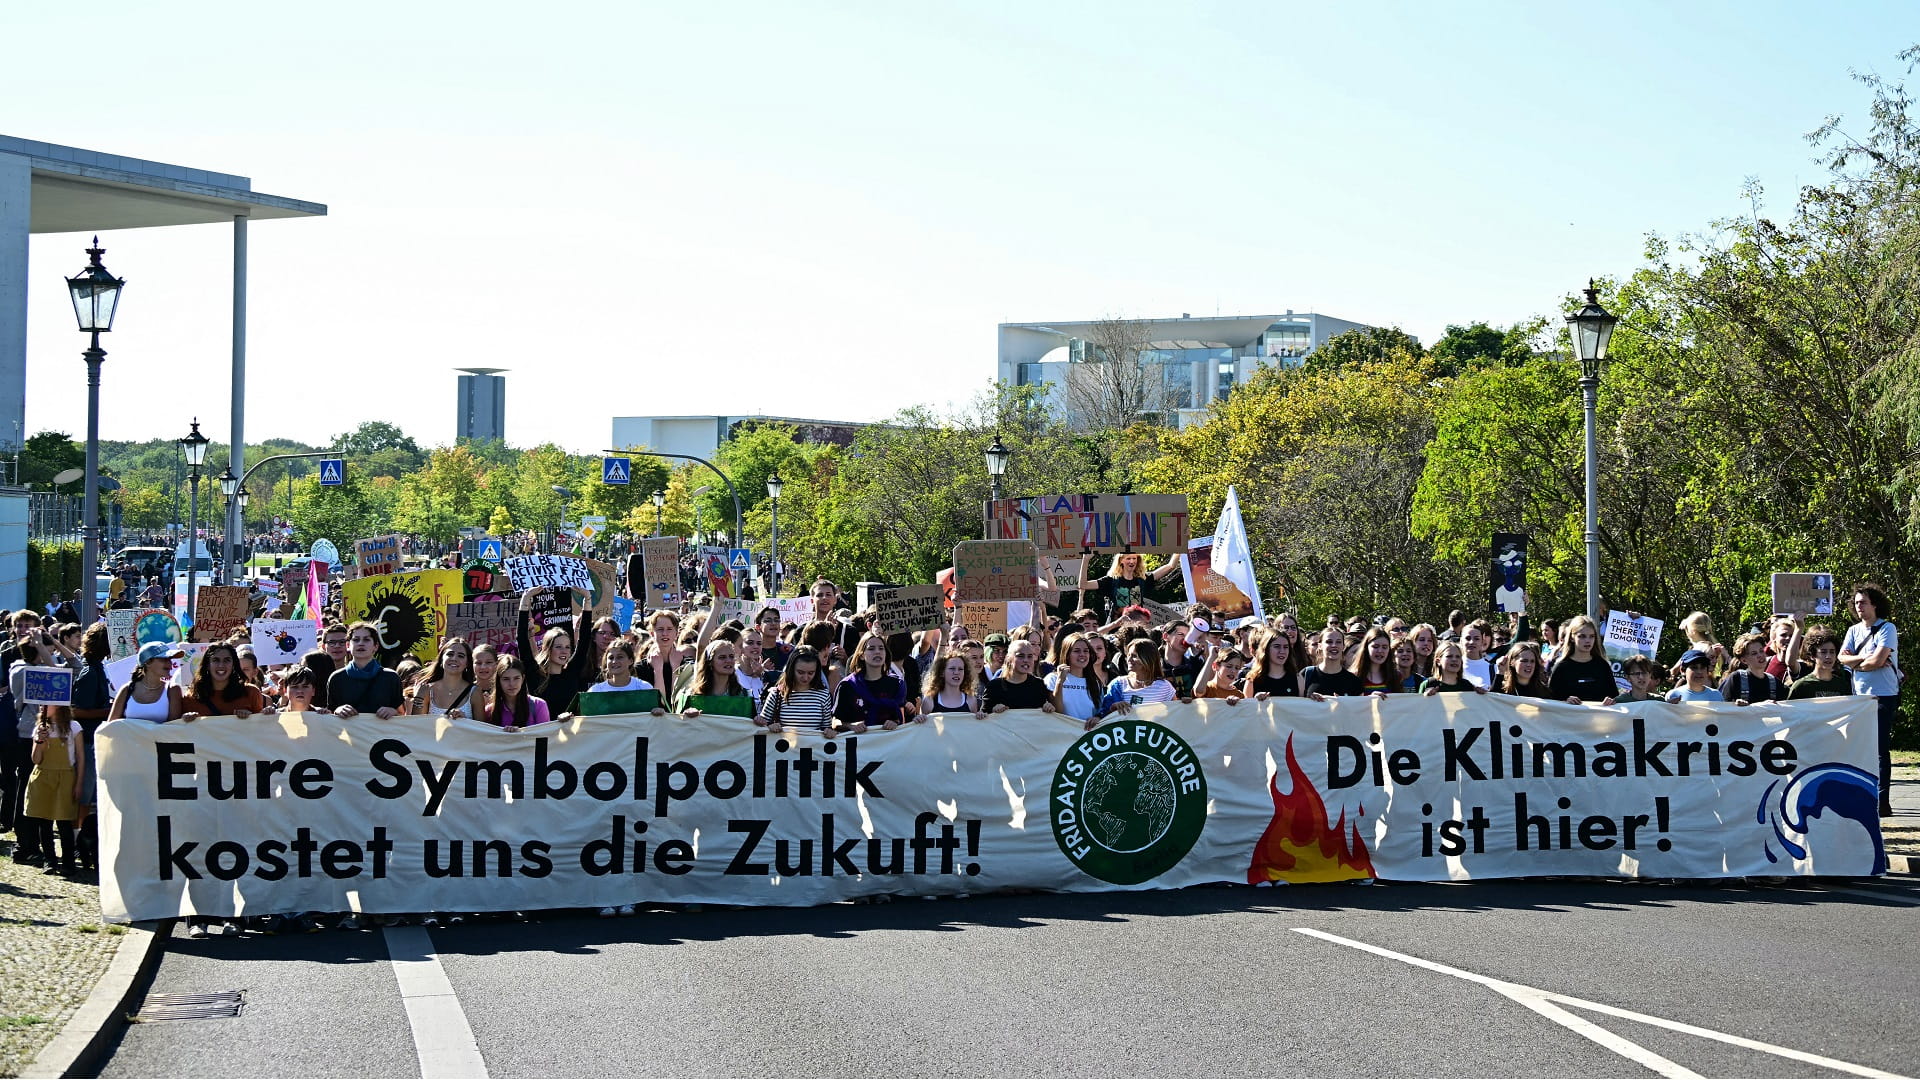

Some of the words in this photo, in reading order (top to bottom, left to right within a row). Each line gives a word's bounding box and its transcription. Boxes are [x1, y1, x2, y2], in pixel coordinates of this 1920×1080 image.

[1079, 511, 1187, 548] ZUKUNFT
[965, 541, 1027, 556] RESPECT
[539, 554, 553, 565] BE
[559, 555, 587, 571] LESS
[957, 555, 1037, 570] EXSISTENCE
[991, 566, 1003, 574] OR
[1054, 562, 1065, 573] A
[511, 564, 557, 579] ACTIVIST
[571, 567, 590, 580] YOU
[512, 577, 527, 592] BE
[530, 575, 557, 588] LESS
[560, 575, 588, 589] SHIT
[964, 573, 1027, 589] EXPECT
[876, 590, 898, 601] EURE
[456, 602, 489, 618] LIKE
[496, 600, 519, 618] THE
[878, 596, 939, 612] SYMBOLPOLITIK
[965, 605, 986, 613] raise
[987, 606, 1000, 614] your
[879, 608, 913, 622] KOSTET
[880, 621, 895, 632] DIE
[978, 622, 988, 630] the
[1611, 624, 1638, 636] THERE
[1640, 629, 1648, 638] IS
[1612, 618, 1643, 630] PROTEST
[1643, 624, 1658, 633] LIKE
[1610, 632, 1655, 646] TOMORROW
[26, 671, 52, 682] SAVE
[1326, 732, 1422, 790] Die
[1442, 718, 1799, 783] Klimakrise
[155, 741, 334, 801] Eure
[365, 734, 884, 817] Symbolpolitik
[1056, 759, 1091, 861] FRIDAYS
[1078, 726, 1128, 762] FOR
[1135, 725, 1200, 796] FUTURE
[1420, 802, 1490, 858] ist
[1515, 791, 1673, 853] hier!
[156, 815, 394, 882] kostet
[423, 838, 554, 879] uns
[579, 814, 695, 877] die
[723, 811, 982, 877] Zukuft!
